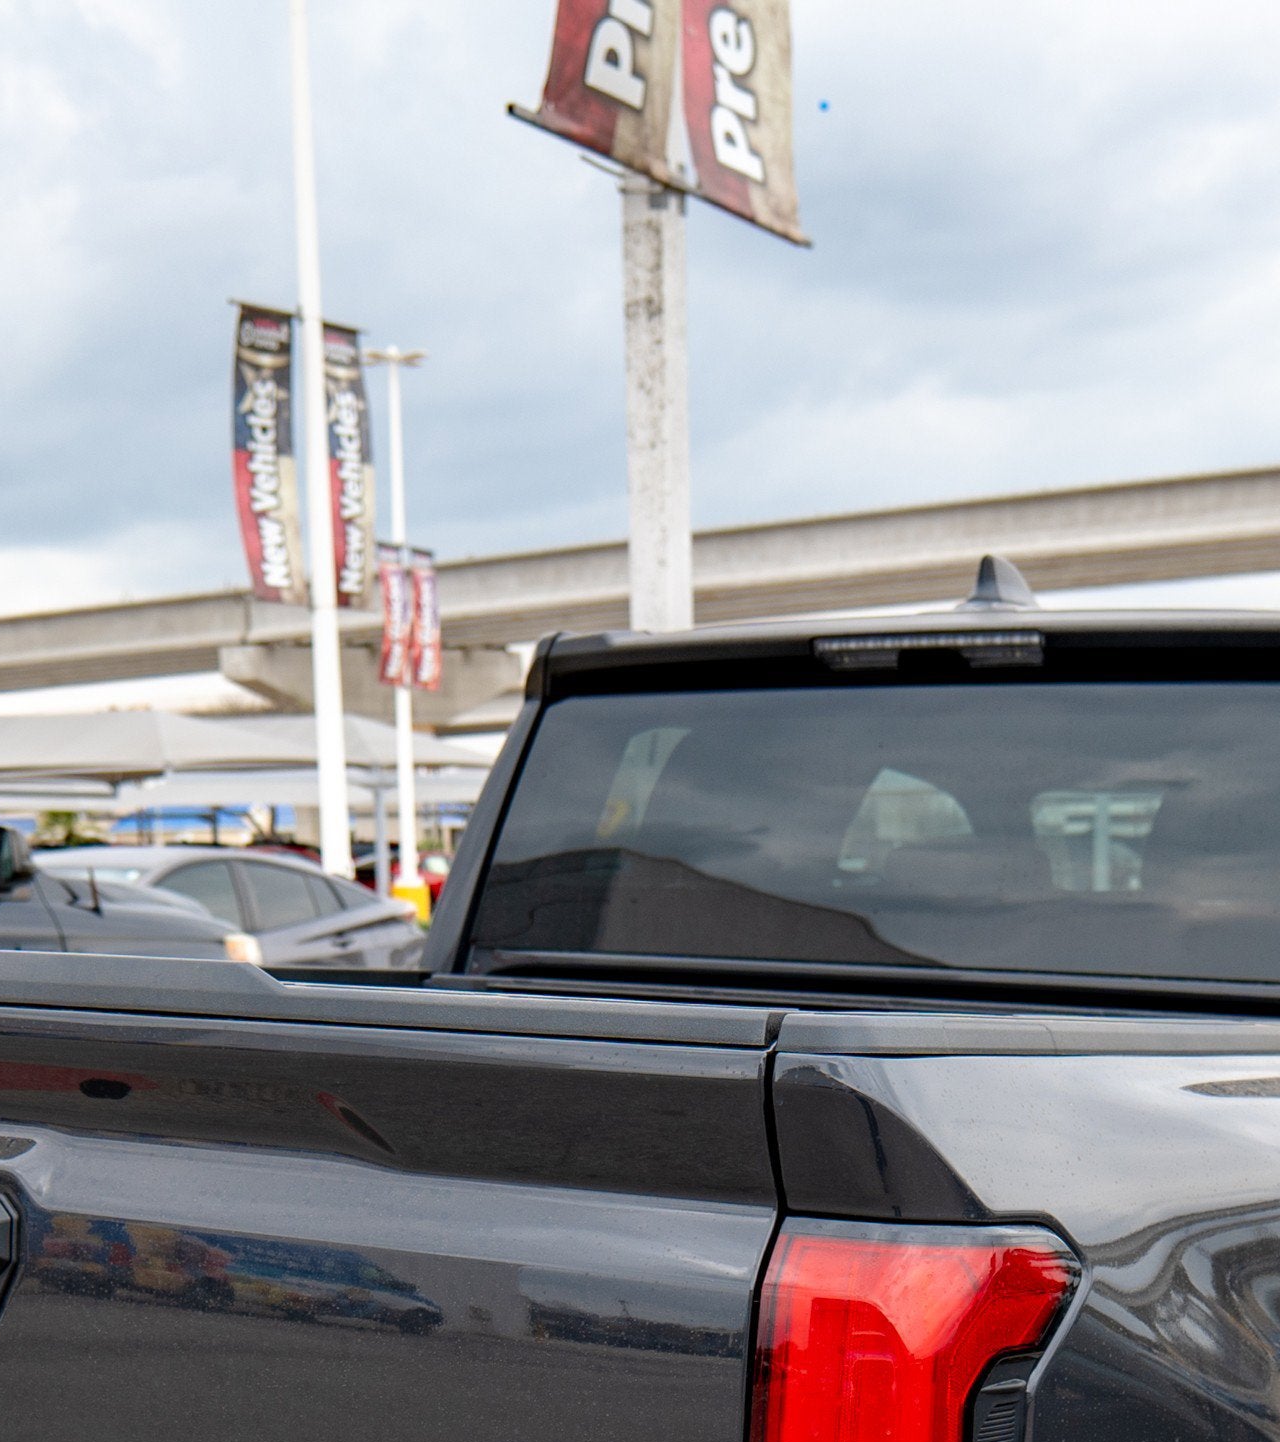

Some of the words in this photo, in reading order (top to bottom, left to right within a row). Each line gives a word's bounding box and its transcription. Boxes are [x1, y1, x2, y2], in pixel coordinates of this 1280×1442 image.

[246, 377, 279, 513] Vehicles
[333, 390, 366, 520] Vehicles
[260, 518, 293, 588] New
[339, 524, 366, 594] New
